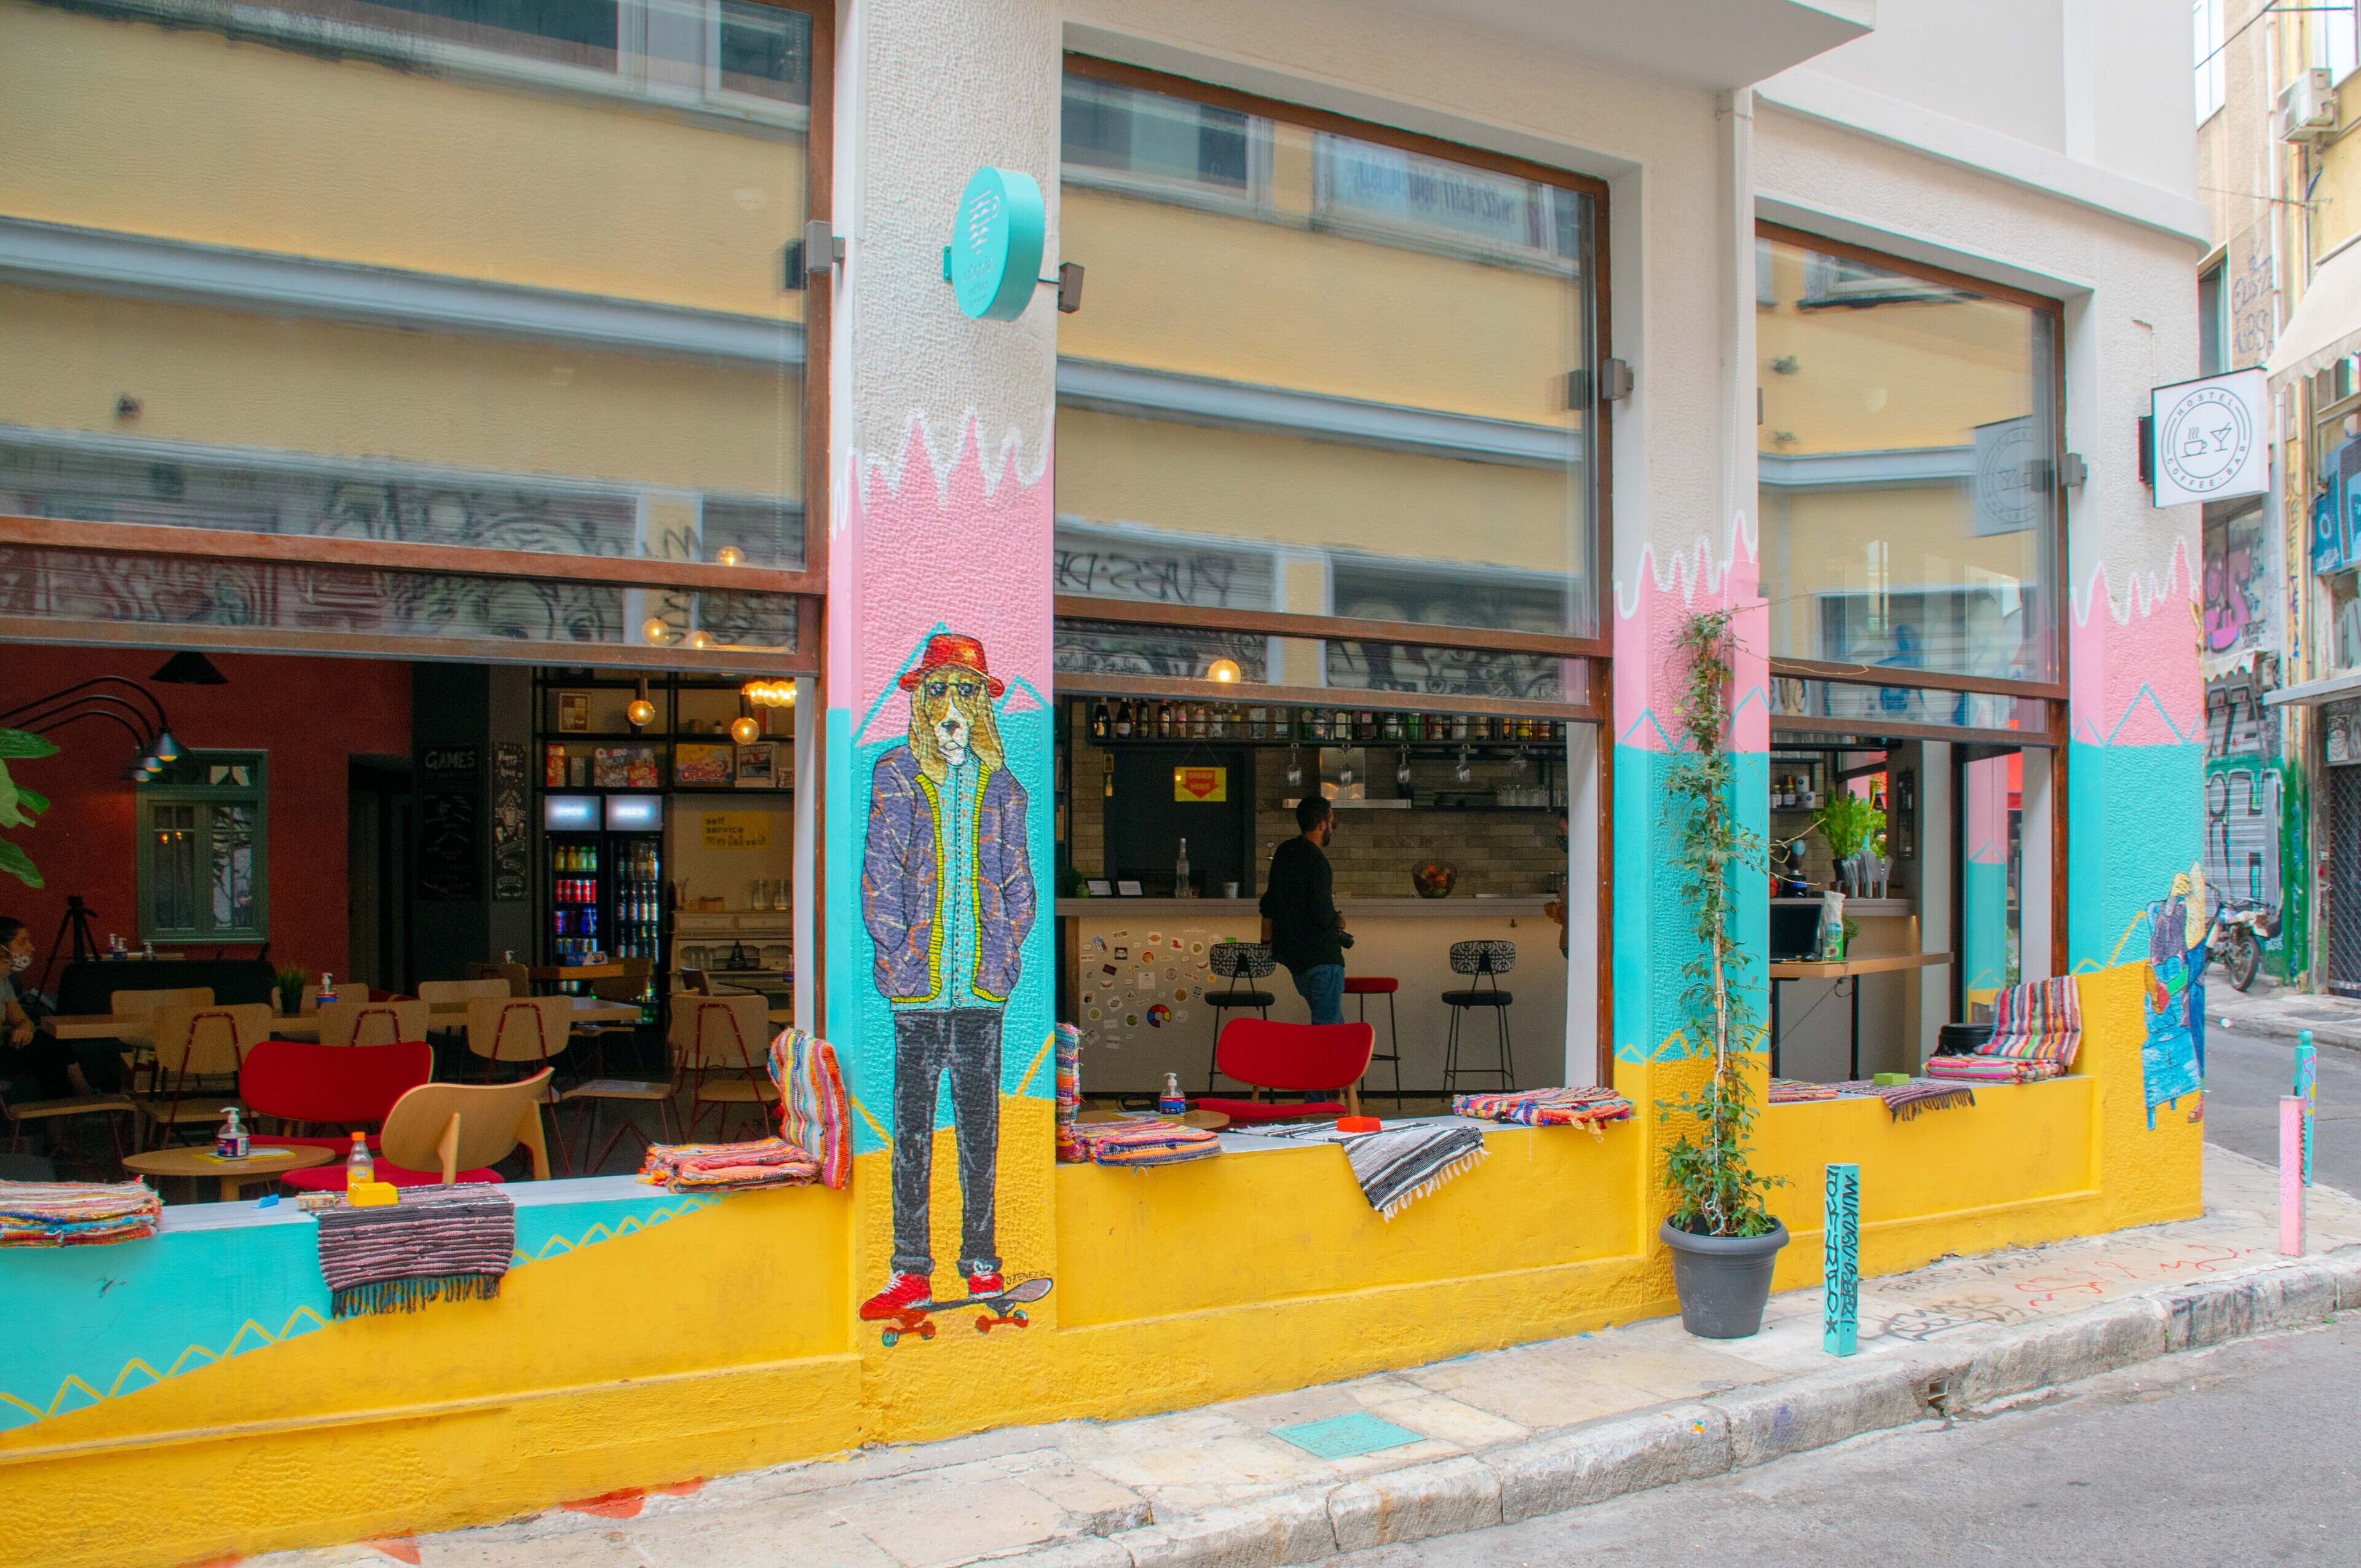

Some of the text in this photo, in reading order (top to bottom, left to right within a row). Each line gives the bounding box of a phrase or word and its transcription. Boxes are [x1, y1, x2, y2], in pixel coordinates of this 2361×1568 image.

[2177, 392, 2234, 416] HOSTEL
[424, 751, 475, 770] GAMES
[706, 816, 725, 825] self
